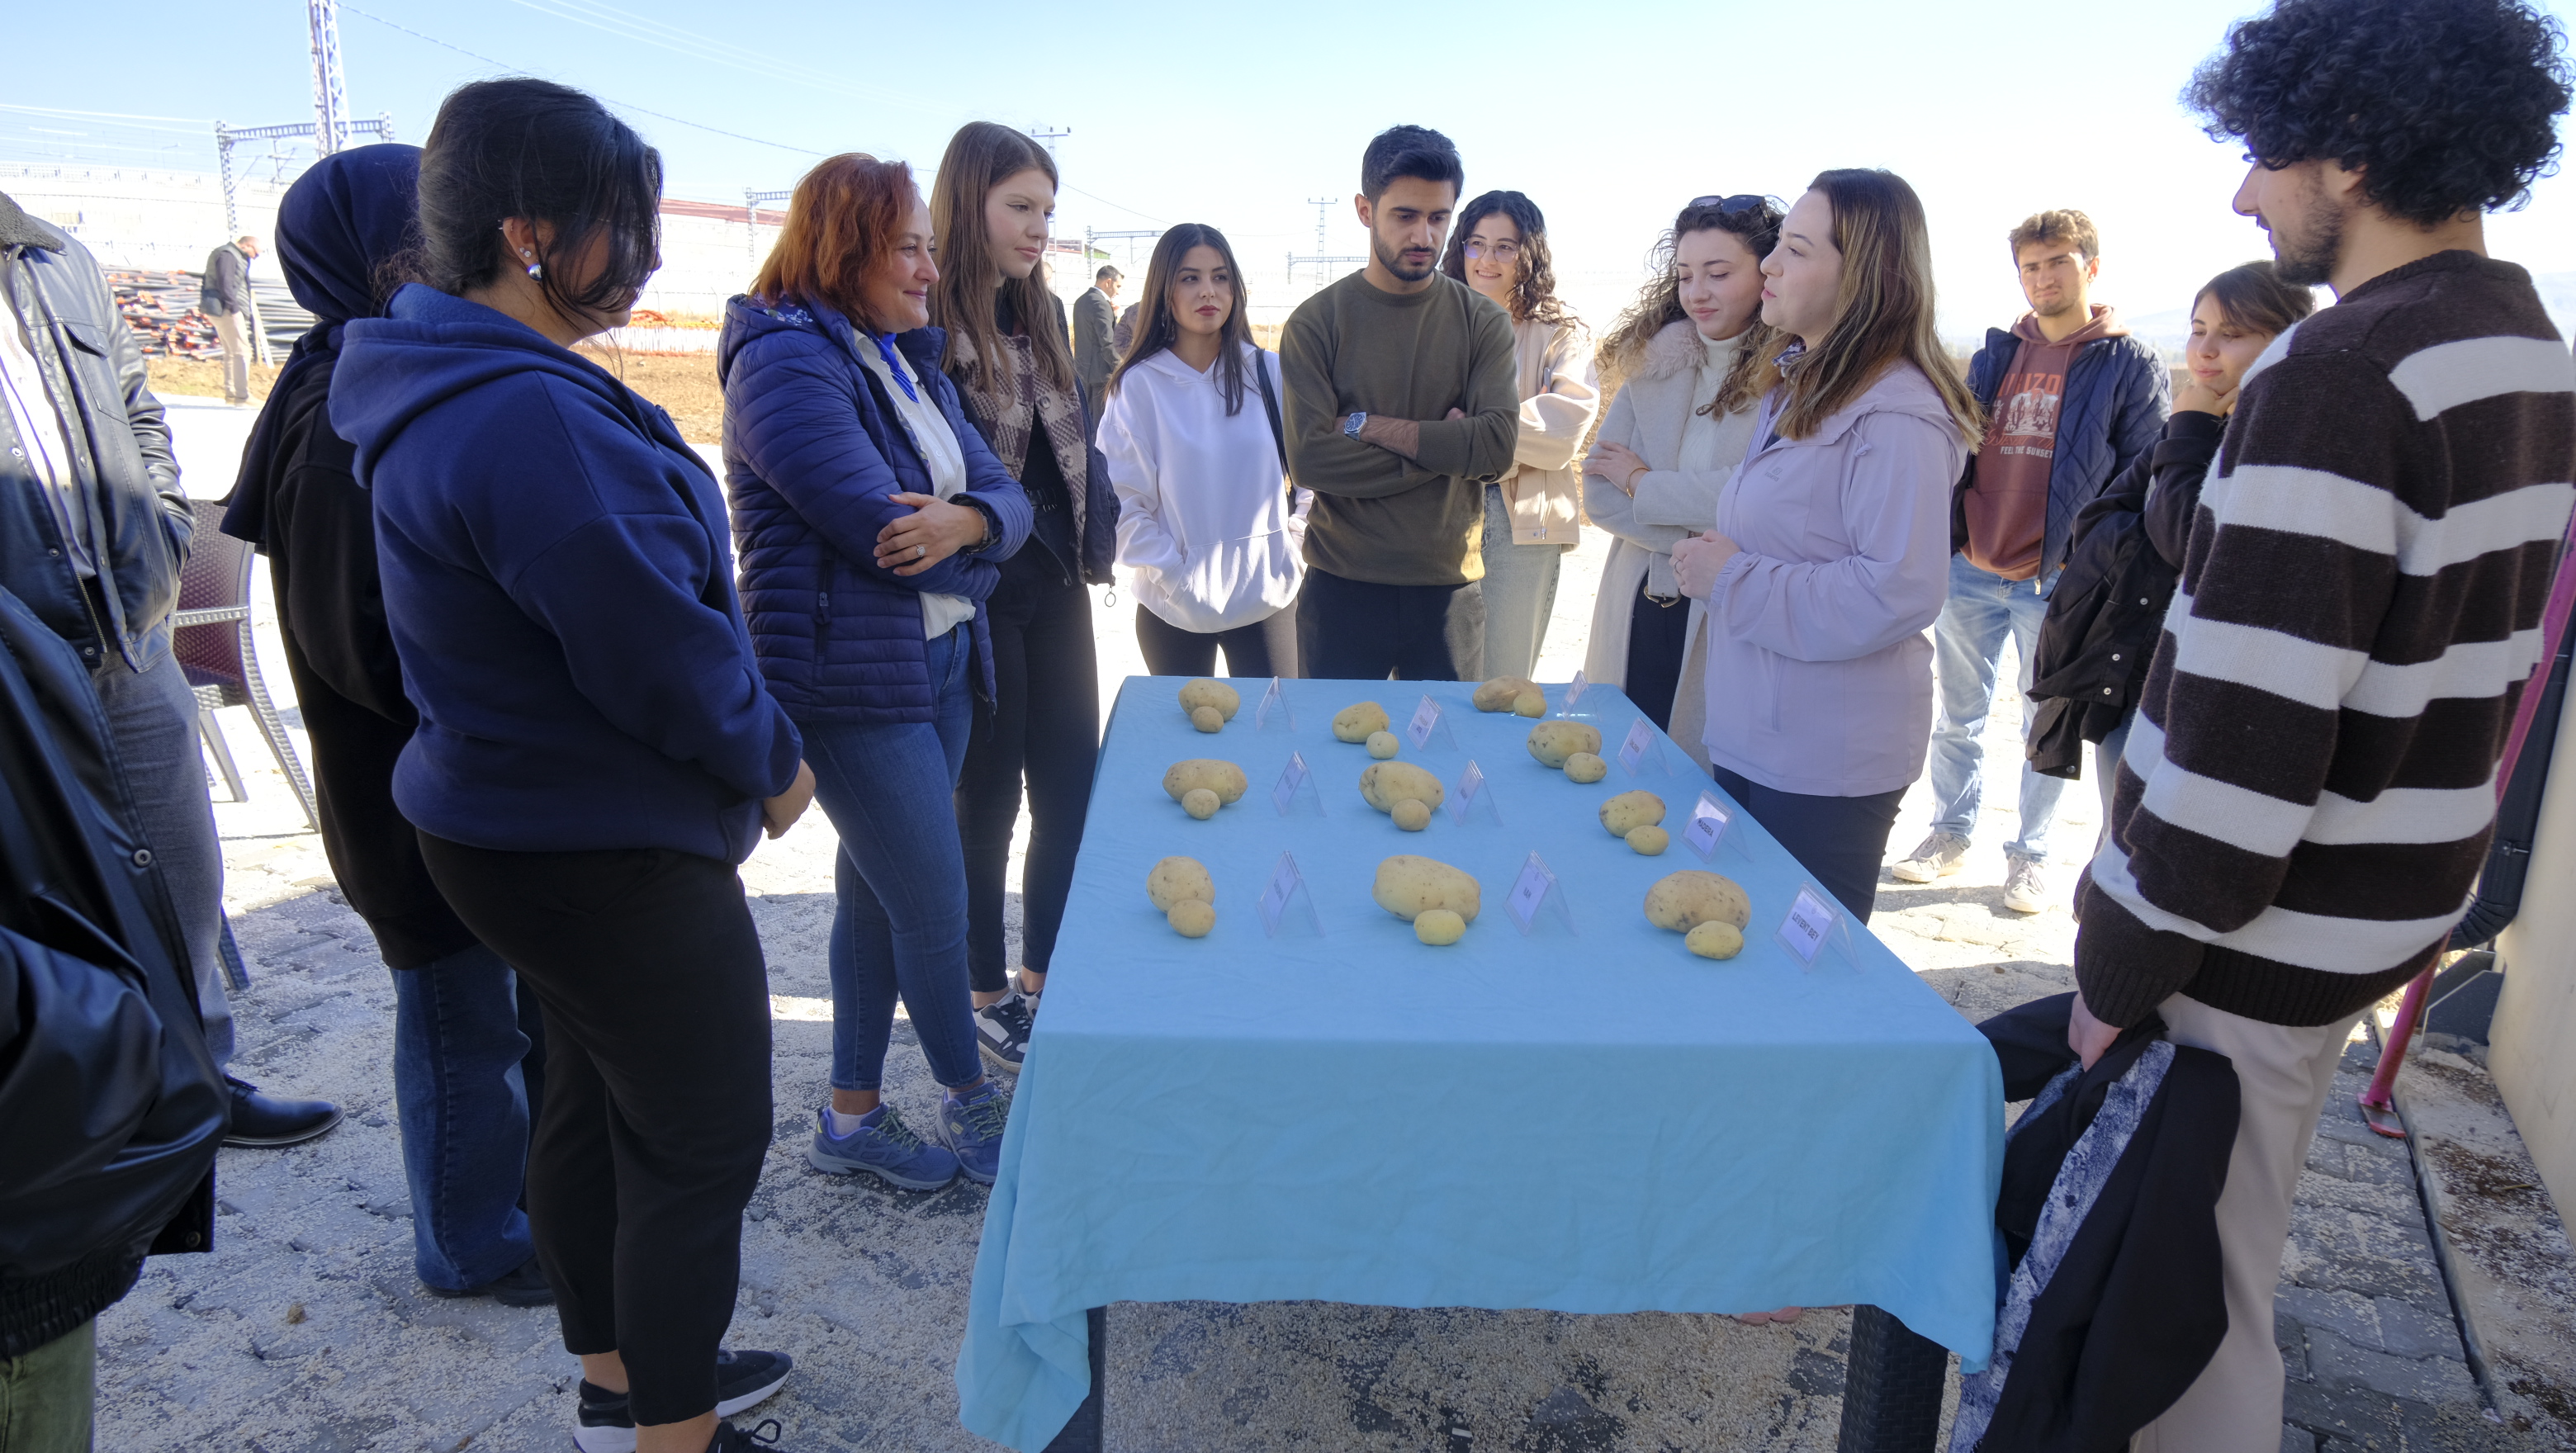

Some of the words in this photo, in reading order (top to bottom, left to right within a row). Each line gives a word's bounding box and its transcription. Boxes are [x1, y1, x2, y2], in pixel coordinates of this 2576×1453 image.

[2001, 447, 2014, 455] FEEL
[2015, 446, 2025, 454] THE
[2026, 447, 2053, 458] SUNSET
[1698, 818, 1713, 837] MADEIRA
[1792, 911, 1811, 933] LEVENT
[1807, 926, 1820, 942] BEY
